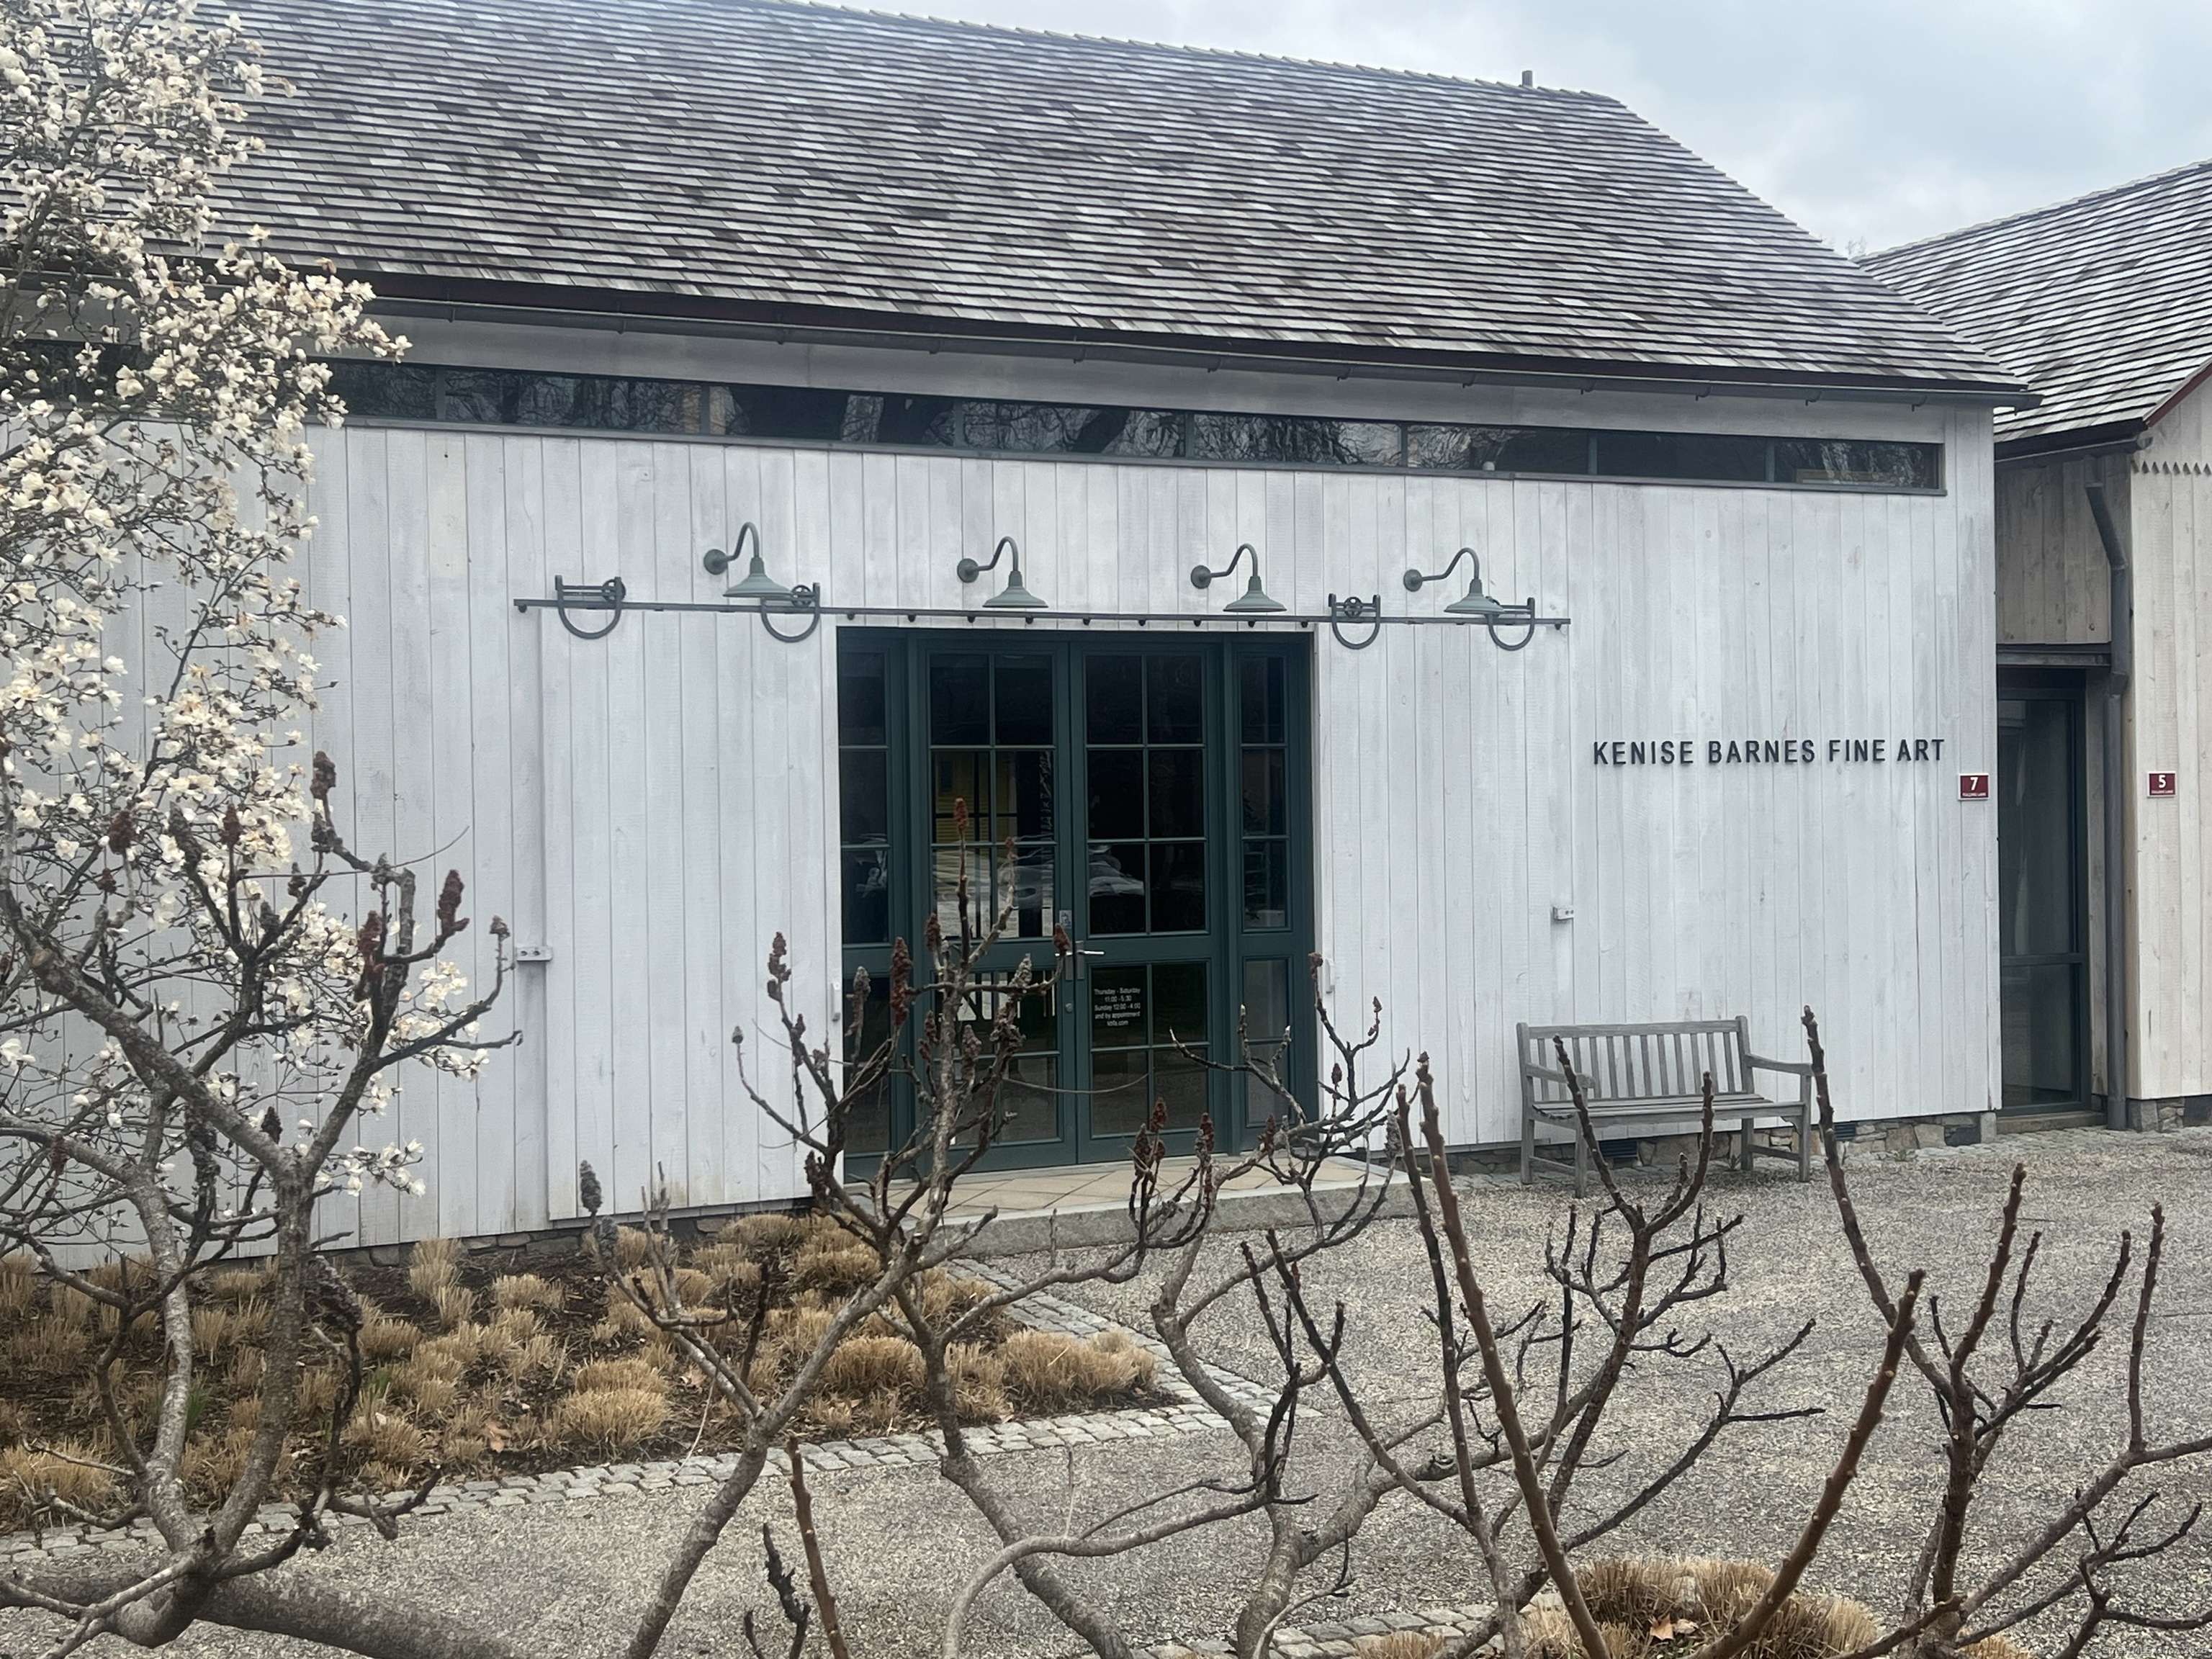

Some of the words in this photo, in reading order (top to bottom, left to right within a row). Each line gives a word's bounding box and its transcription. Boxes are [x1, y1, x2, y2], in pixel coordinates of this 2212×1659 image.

[1593, 741, 1694, 765] KENISE
[1708, 739, 1815, 763] BARNES
[1828, 739, 1886, 762] FINE
[1897, 739, 1945, 761] ART
[1970, 776, 1979, 791] 7
[2158, 774, 2167, 788] 5
